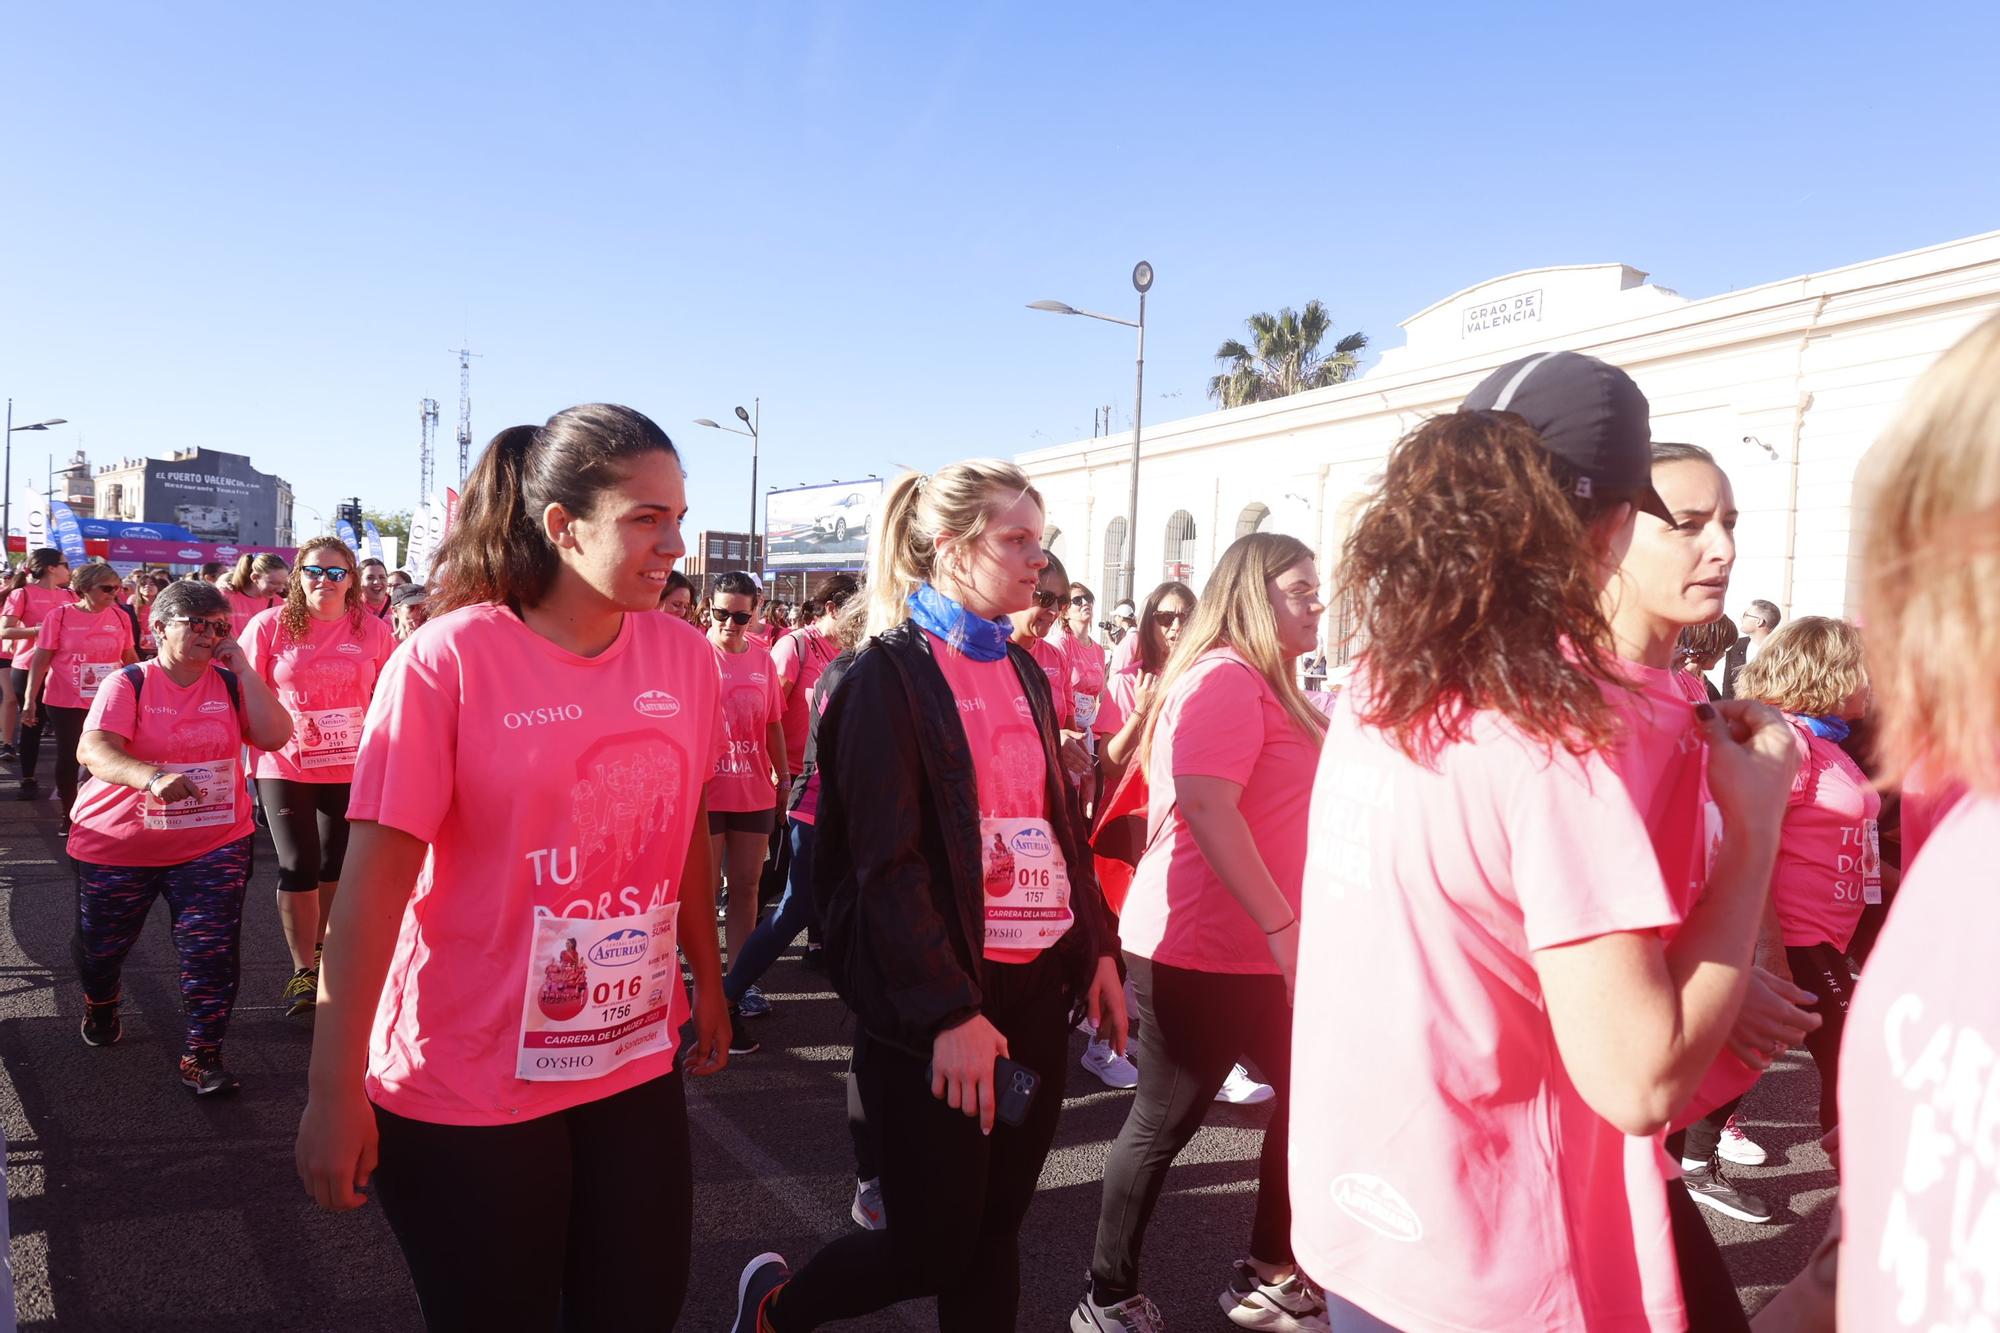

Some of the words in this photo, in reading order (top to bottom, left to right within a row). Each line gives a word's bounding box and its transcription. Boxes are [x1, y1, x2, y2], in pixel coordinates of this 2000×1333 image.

[470, 303, 507, 321] GRAO
[515, 296, 534, 310] DE
[467, 308, 536, 333] VALENCIA
[156, 472, 166, 480] EL
[167, 472, 202, 483] PUERTO
[287, 690, 309, 705] TU
[144, 704, 178, 715] OYSHO
[503, 704, 583, 729] OYSHO
[324, 731, 348, 741] 016
[727, 737, 760, 755] ORSAL
[525, 846, 578, 886] TU
[1018, 868, 1050, 887] 016
[1025, 891, 1044, 903] 1757
[1833, 880, 1864, 902] SU
[988, 910, 1022, 918] CARRERA
[984, 927, 1023, 938] OYSHO
[594, 943, 647, 961] ASTURIAN
[592, 975, 643, 1005] 016
[1823, 970, 1842, 993] THE
[601, 1004, 631, 1023] 1756
[544, 1035, 595, 1045] CARRERA
[597, 1031, 611, 1041] DE
[611, 1029, 623, 1038] LA
[622, 1018, 644, 1035] MUJER
[624, 1030, 658, 1051] Santander
[536, 1055, 594, 1069] OYSHO
